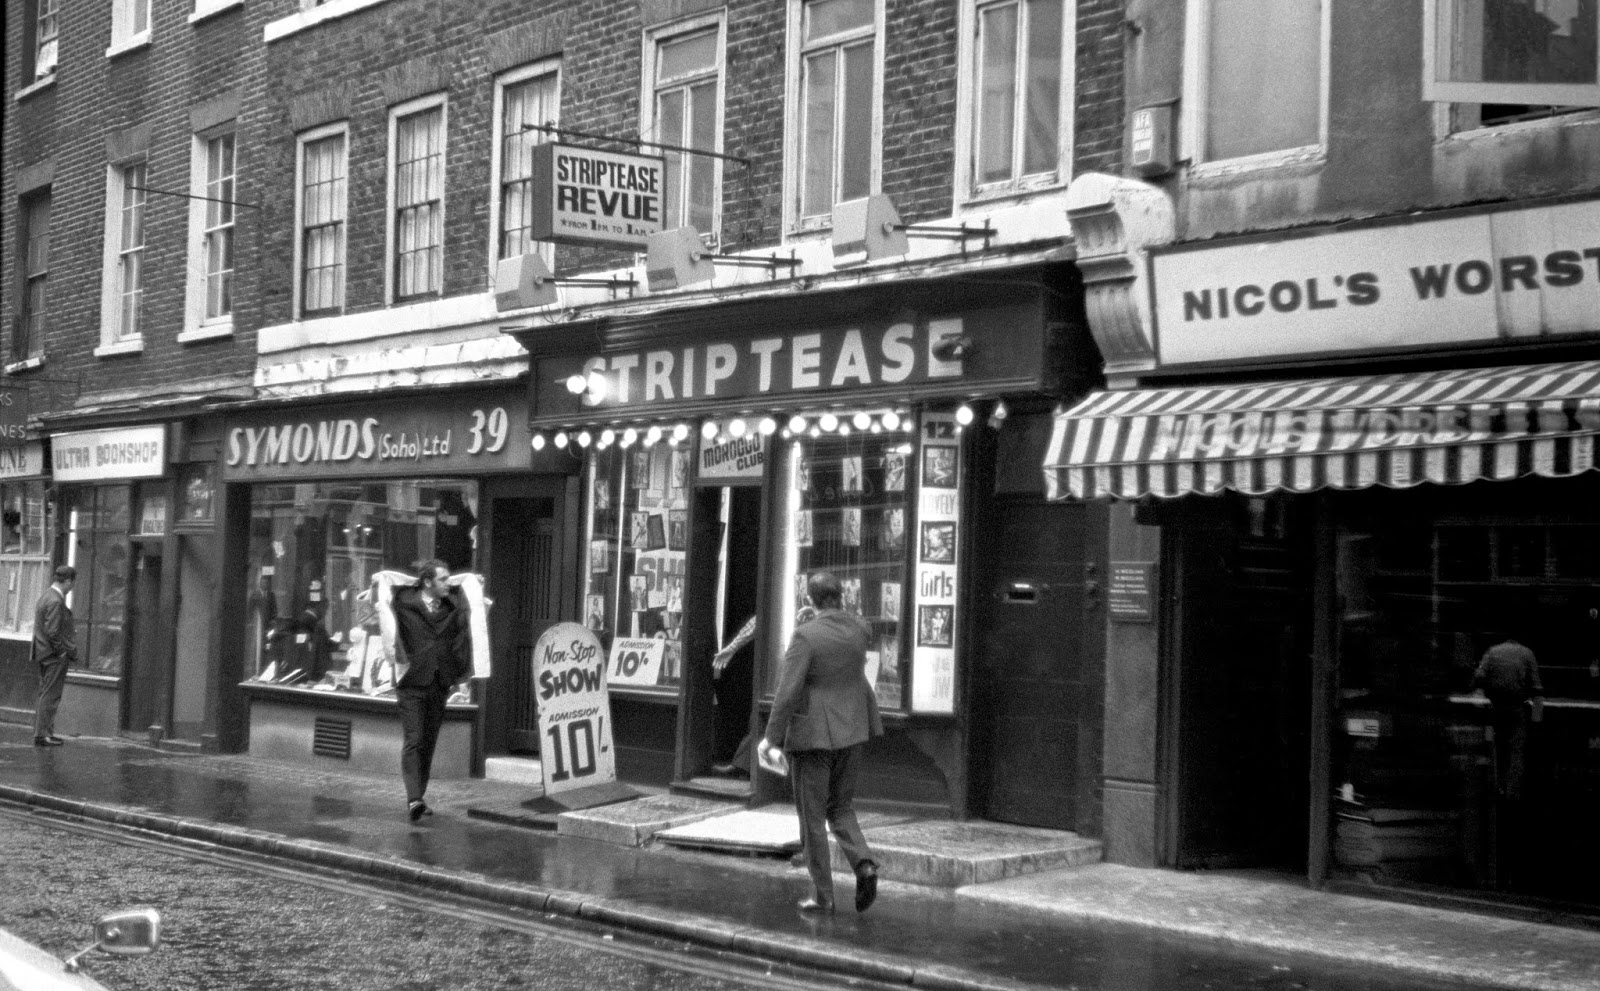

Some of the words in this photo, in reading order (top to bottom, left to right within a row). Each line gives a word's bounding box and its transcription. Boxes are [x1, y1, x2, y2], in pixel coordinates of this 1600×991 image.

[557, 154, 659, 194] STRIPTEASE
[557, 183, 658, 223] REVUE
[568, 220, 588, 230] FROM
[612, 225, 623, 234] TO
[1183, 271, 1381, 322] NICOL'S
[581, 318, 964, 406] STRIPTEASE
[226, 417, 379, 466] SYMONDS
[422, 428, 451, 456] Ltd
[466, 406, 510, 455] 39
[56, 446, 91, 470] ULTRA
[96, 441, 159, 467] BOOKSHOP
[736, 451, 765, 472] CLUB
[920, 570, 954, 599] Girls
[543, 639, 597, 665] Non-Stop
[619, 641, 656, 650] ADMISSION
[539, 663, 602, 700] SHOW
[548, 706, 600, 724] ADMISSION
